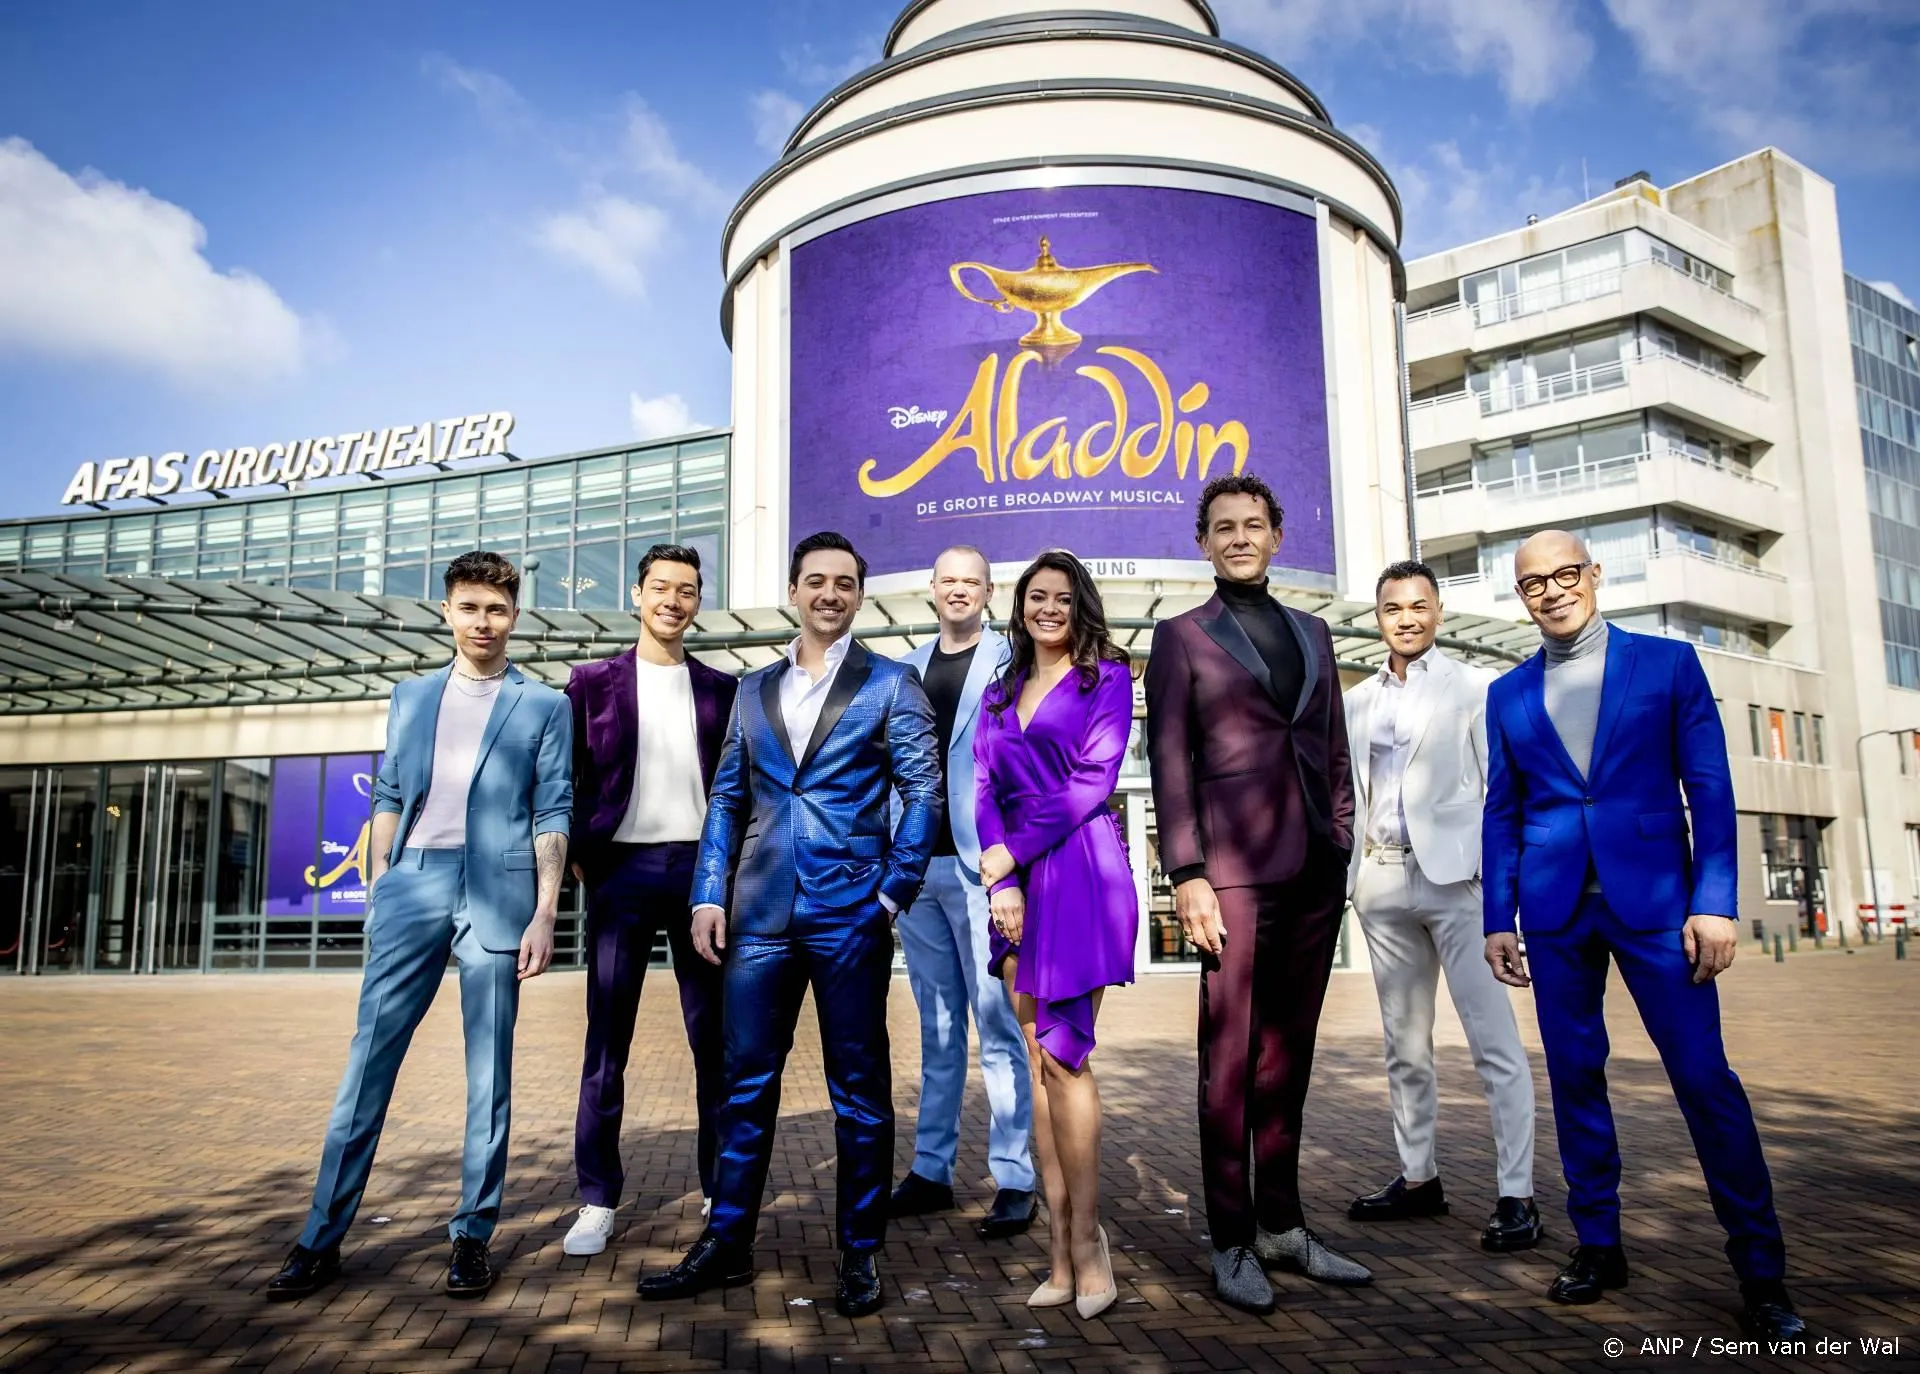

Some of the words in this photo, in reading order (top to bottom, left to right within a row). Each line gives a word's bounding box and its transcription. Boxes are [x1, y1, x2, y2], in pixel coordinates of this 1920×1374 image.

[858, 346, 1250, 498] Aladdin
[60, 452, 188, 505] AFAS
[190, 411, 515, 491] CIRCUSTHEATER
[916, 501, 937, 516] DE
[943, 495, 999, 512] GROTE
[1004, 490, 1104, 507] BROADWAY
[1110, 490, 1185, 504] MUSICAL
[1084, 561, 1136, 575] SUNG
